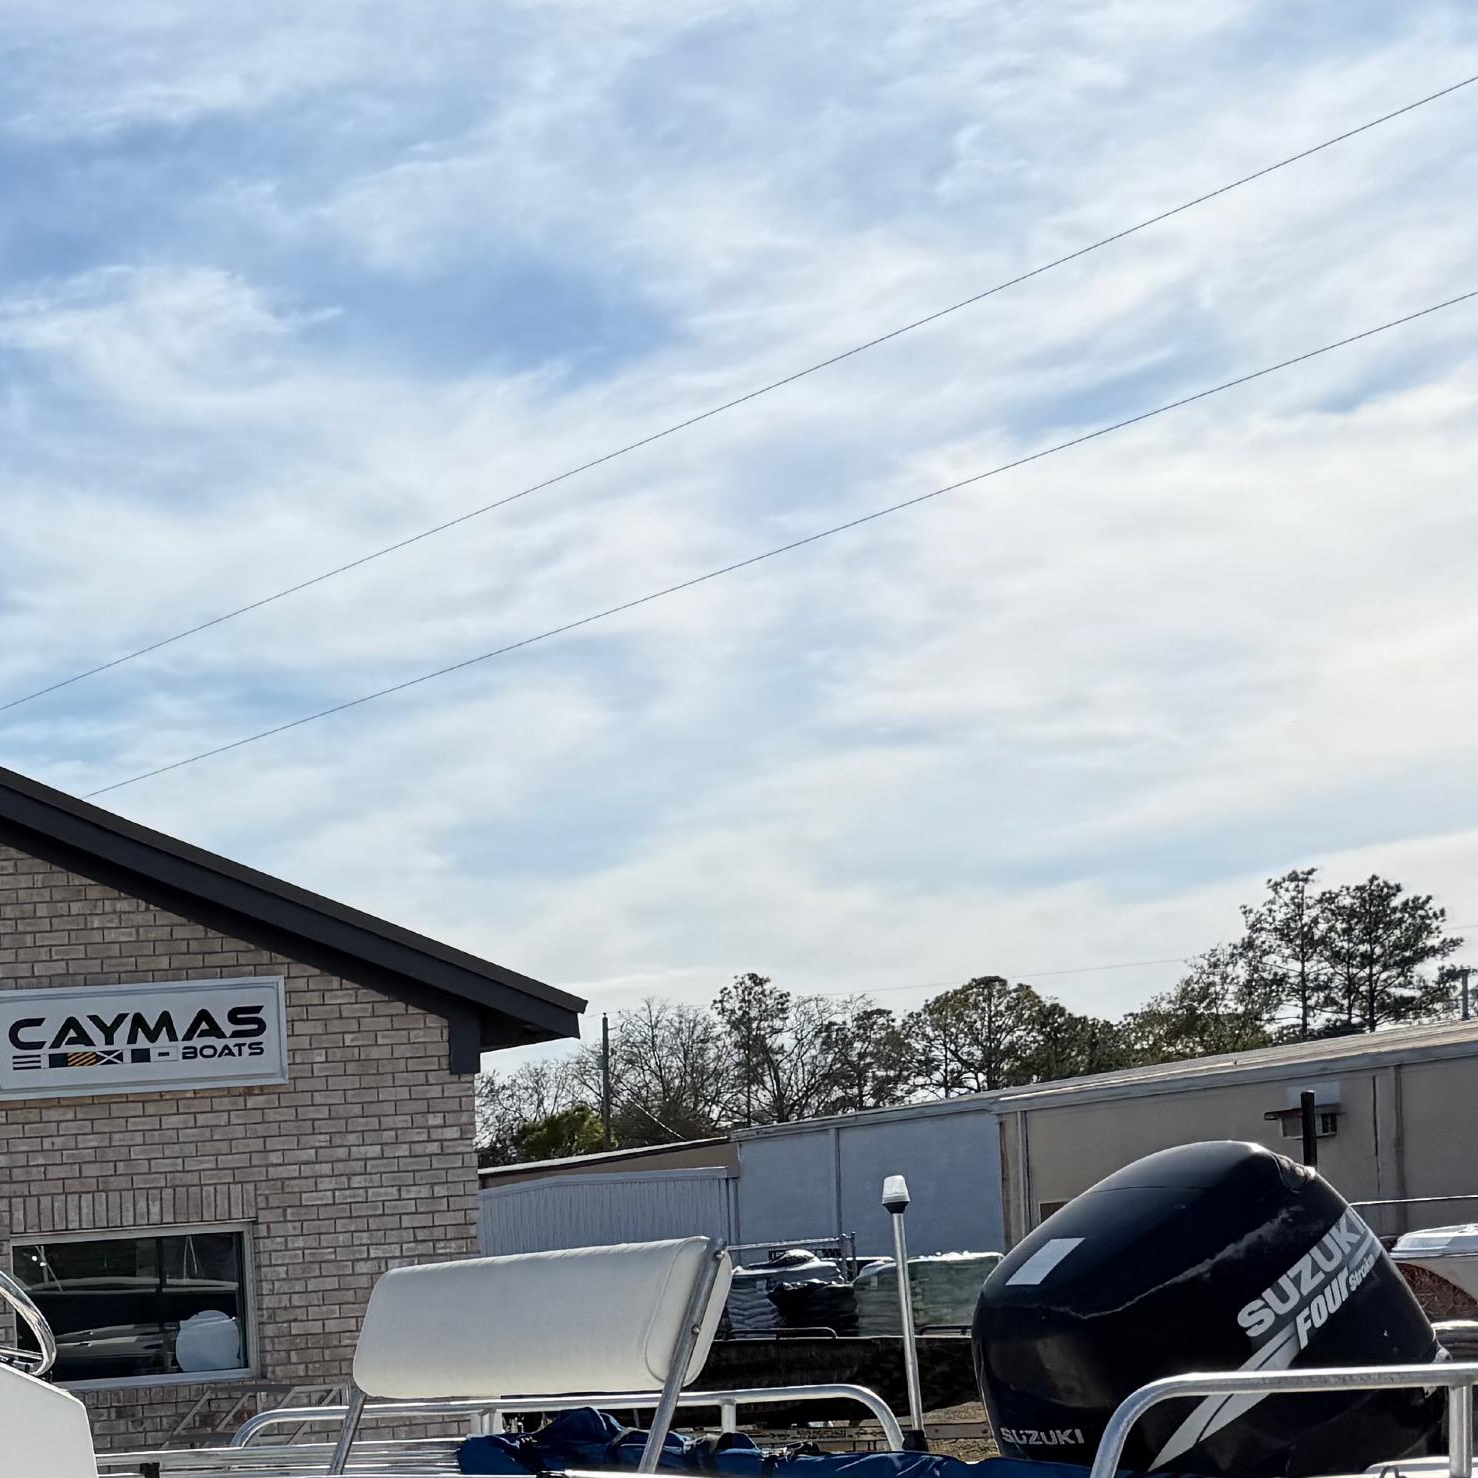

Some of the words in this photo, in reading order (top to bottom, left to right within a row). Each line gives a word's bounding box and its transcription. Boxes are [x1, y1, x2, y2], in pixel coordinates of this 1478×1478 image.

[8, 1005, 267, 1050] CAYMAS
[182, 1041, 264, 1060] BOATS
[1000, 1427, 1085, 1445] SUZUKI
